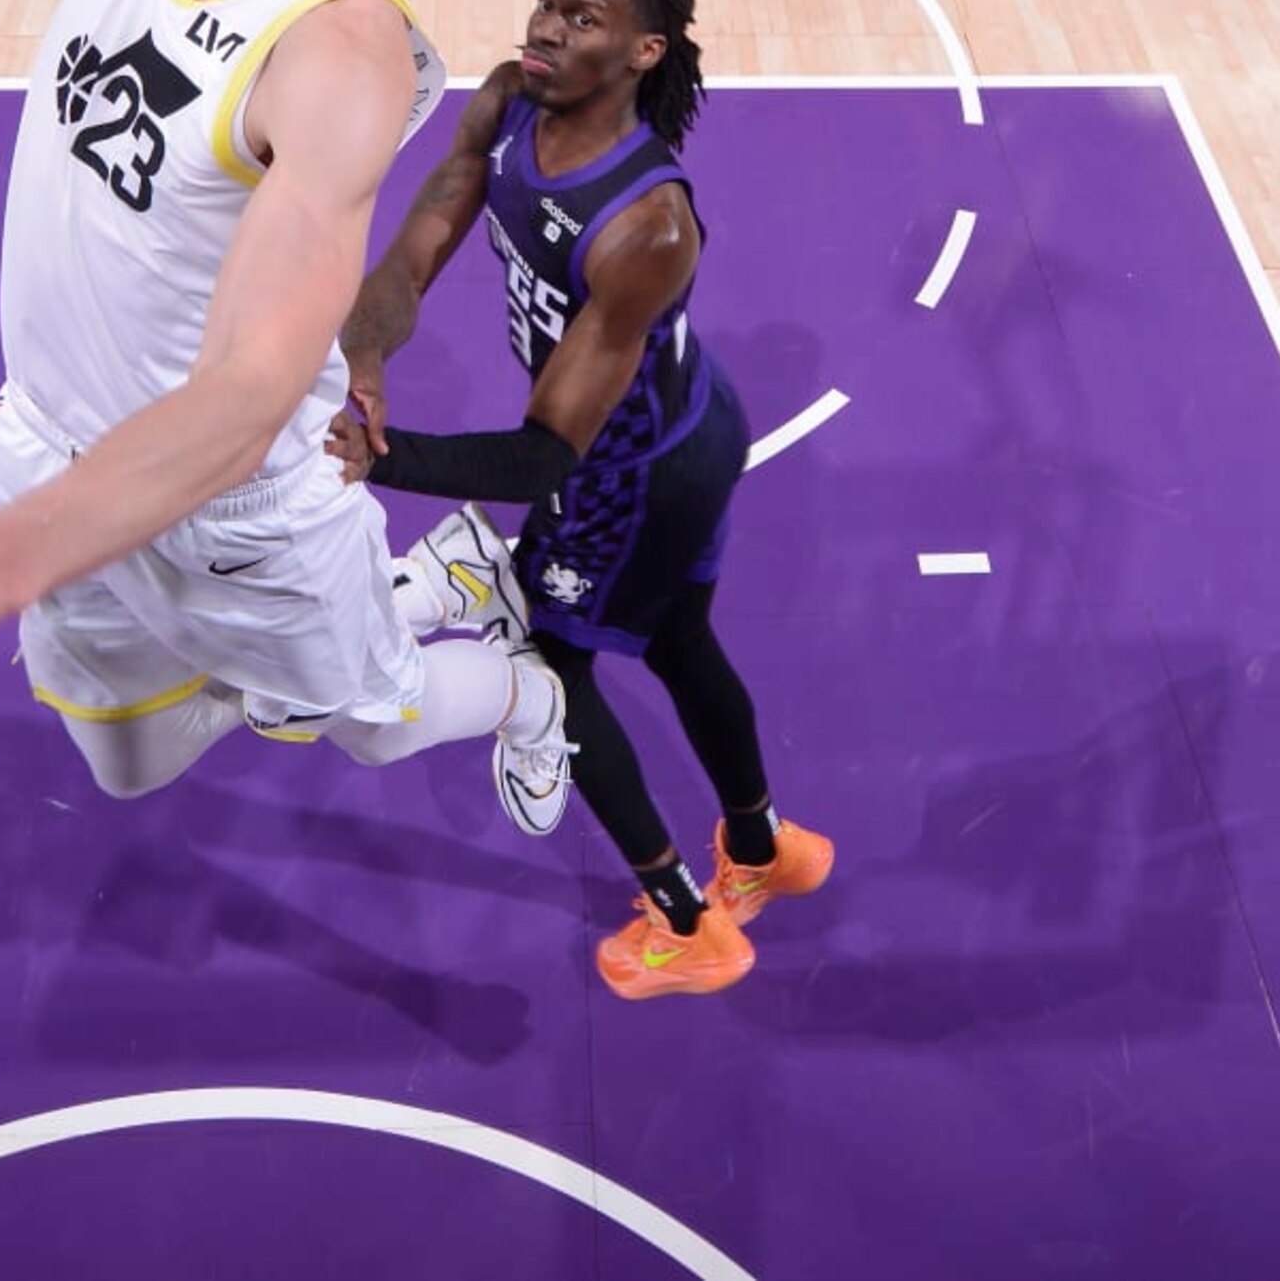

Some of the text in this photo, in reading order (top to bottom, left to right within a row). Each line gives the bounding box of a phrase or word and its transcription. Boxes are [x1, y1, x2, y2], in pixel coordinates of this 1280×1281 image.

[184, 9, 247, 63] LVT
[70, 74, 166, 214] 23
[539, 195, 584, 238] dialpad
